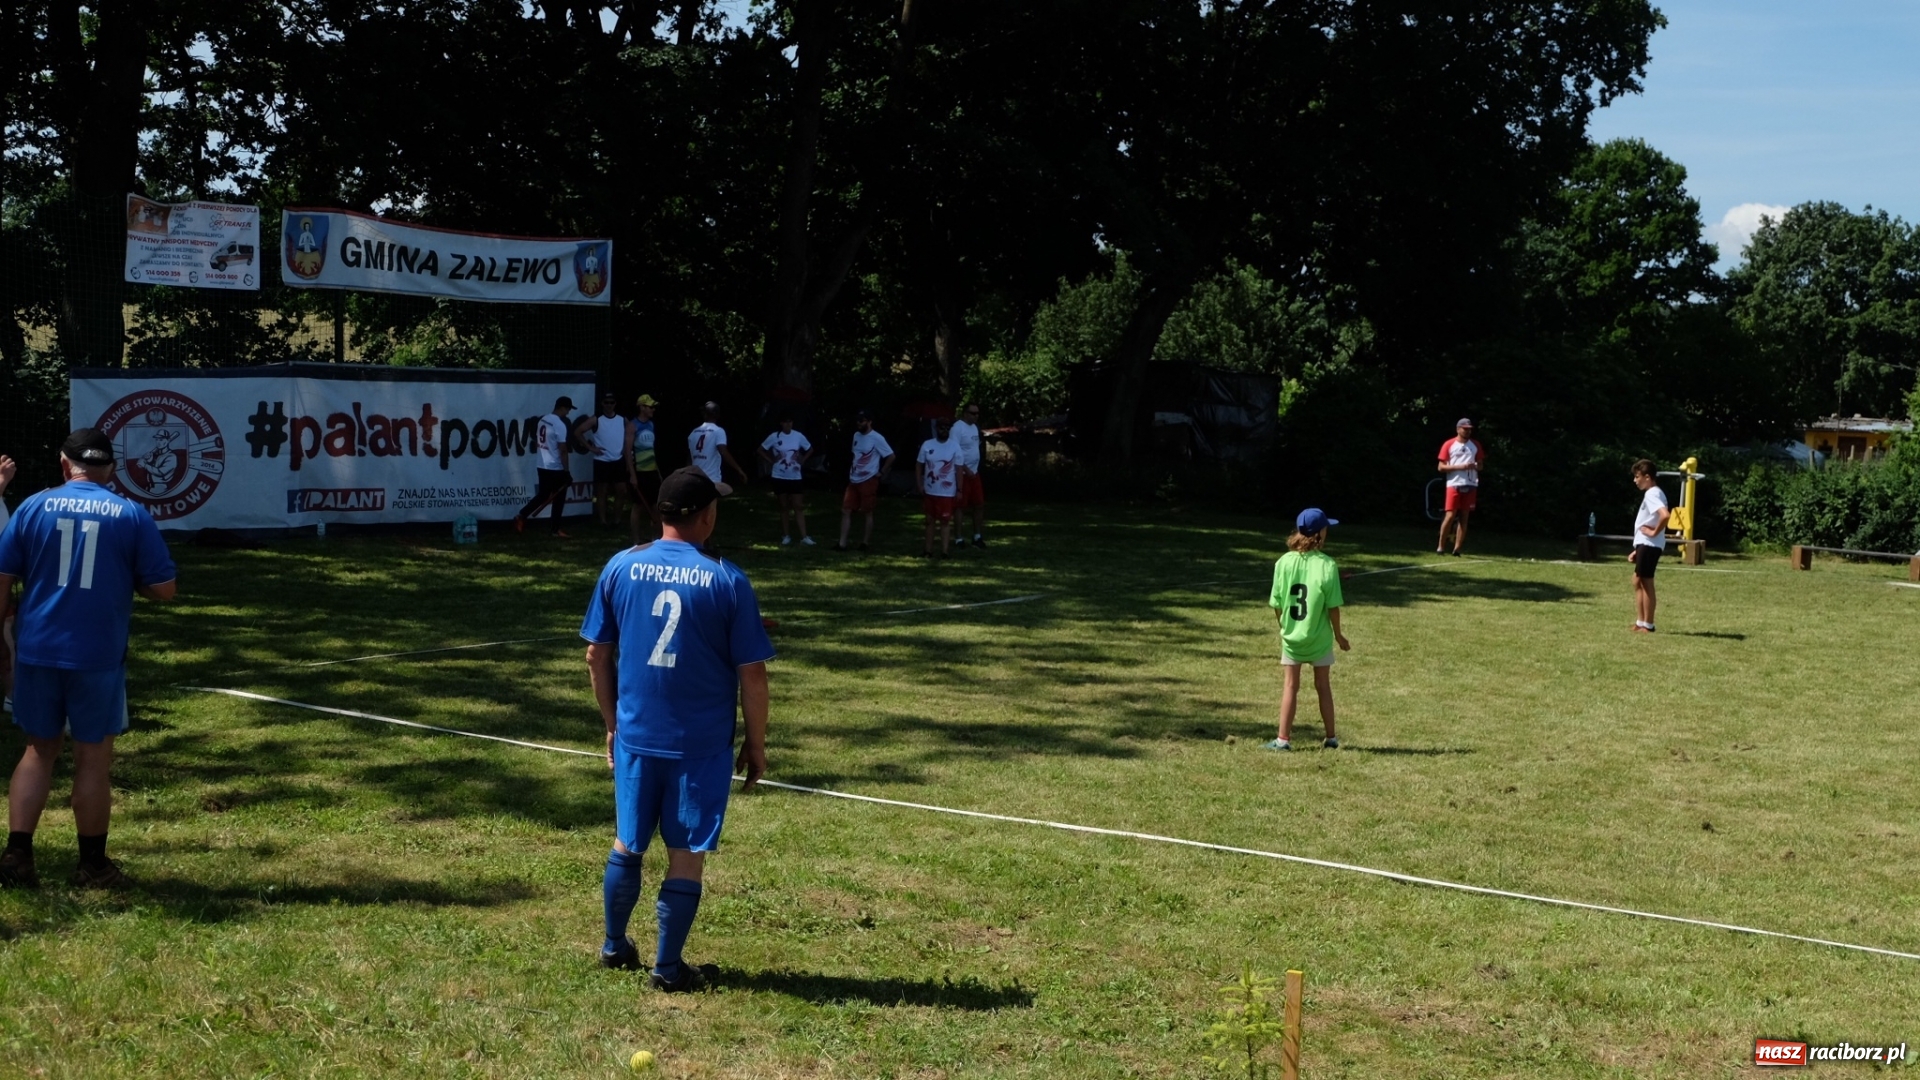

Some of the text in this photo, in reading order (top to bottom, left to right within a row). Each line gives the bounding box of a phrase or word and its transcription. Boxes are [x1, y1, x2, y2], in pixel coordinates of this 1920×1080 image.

[190, 239, 218, 247] MEDYCZNY
[340, 236, 561, 285] GMINA ZALEWO
[100, 396, 212, 435] POLSKIE STOWARZYSZENIE
[540, 425, 546, 443] 9
[696, 434, 706, 453] 4
[392, 500, 425, 509] POLSKIE
[427, 498, 490, 508] STOWARZYSZENIE
[398, 485, 527, 500] ZNAJDŹ NAS NA FACEBOOKU!
[44, 497, 123, 518] CYPRZANÓW
[56, 518, 100, 590] 11
[630, 563, 714, 588] CYPRZANÓW
[1289, 583, 1308, 621] 3
[647, 589, 682, 668] 2
